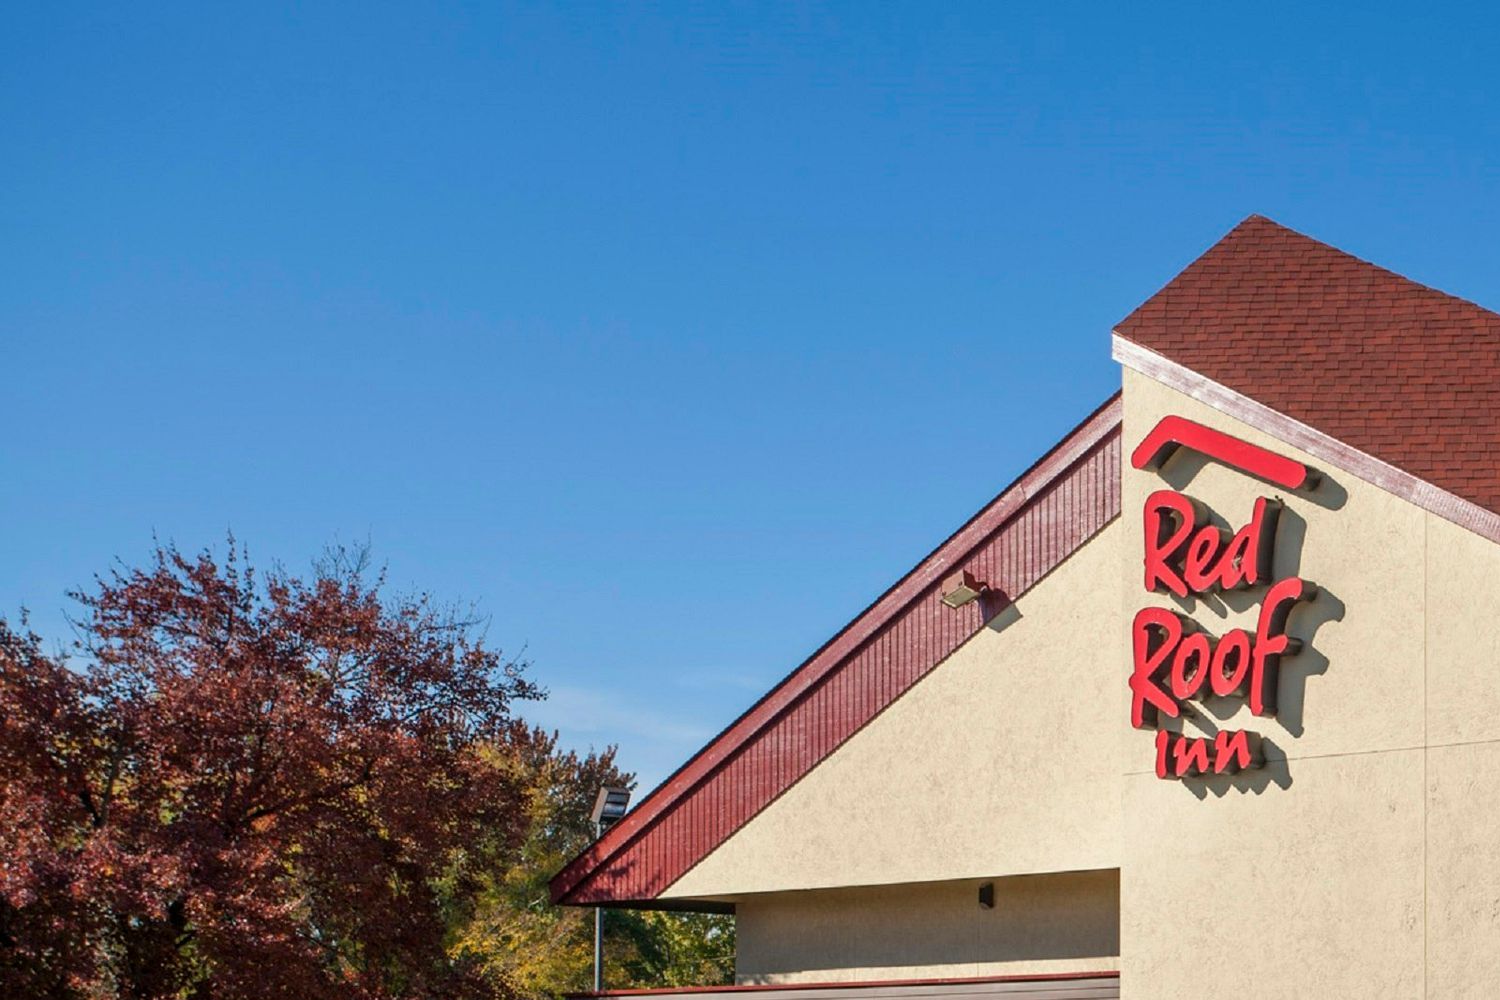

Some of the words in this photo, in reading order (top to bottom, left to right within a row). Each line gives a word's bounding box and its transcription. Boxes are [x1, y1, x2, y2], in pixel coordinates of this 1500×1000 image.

[1144, 490, 1267, 598] Red
[1129, 577, 1302, 729] Roof
[1155, 729, 1252, 780] Inn
